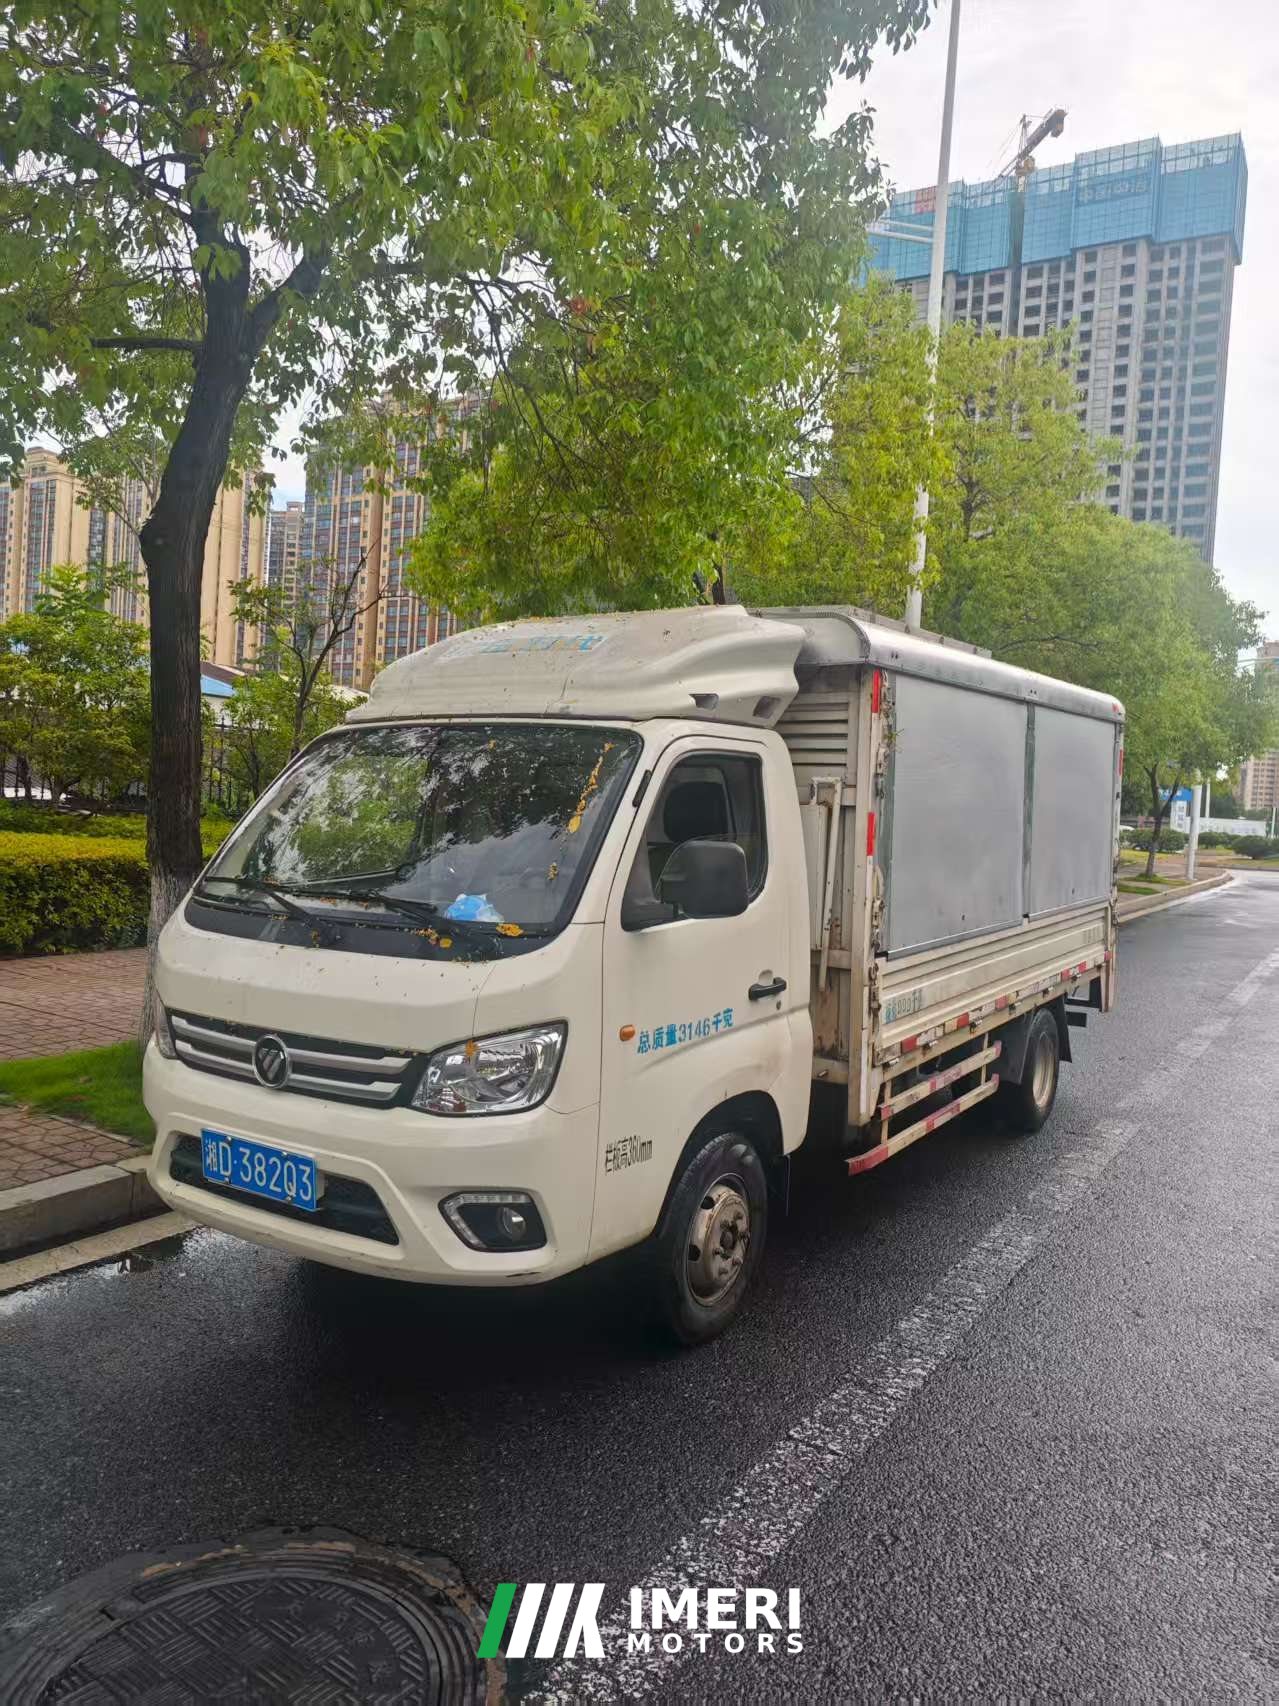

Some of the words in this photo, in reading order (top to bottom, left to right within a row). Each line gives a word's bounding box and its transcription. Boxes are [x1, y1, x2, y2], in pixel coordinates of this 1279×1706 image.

[637, 1007, 734, 1054] 总质量3146千克
